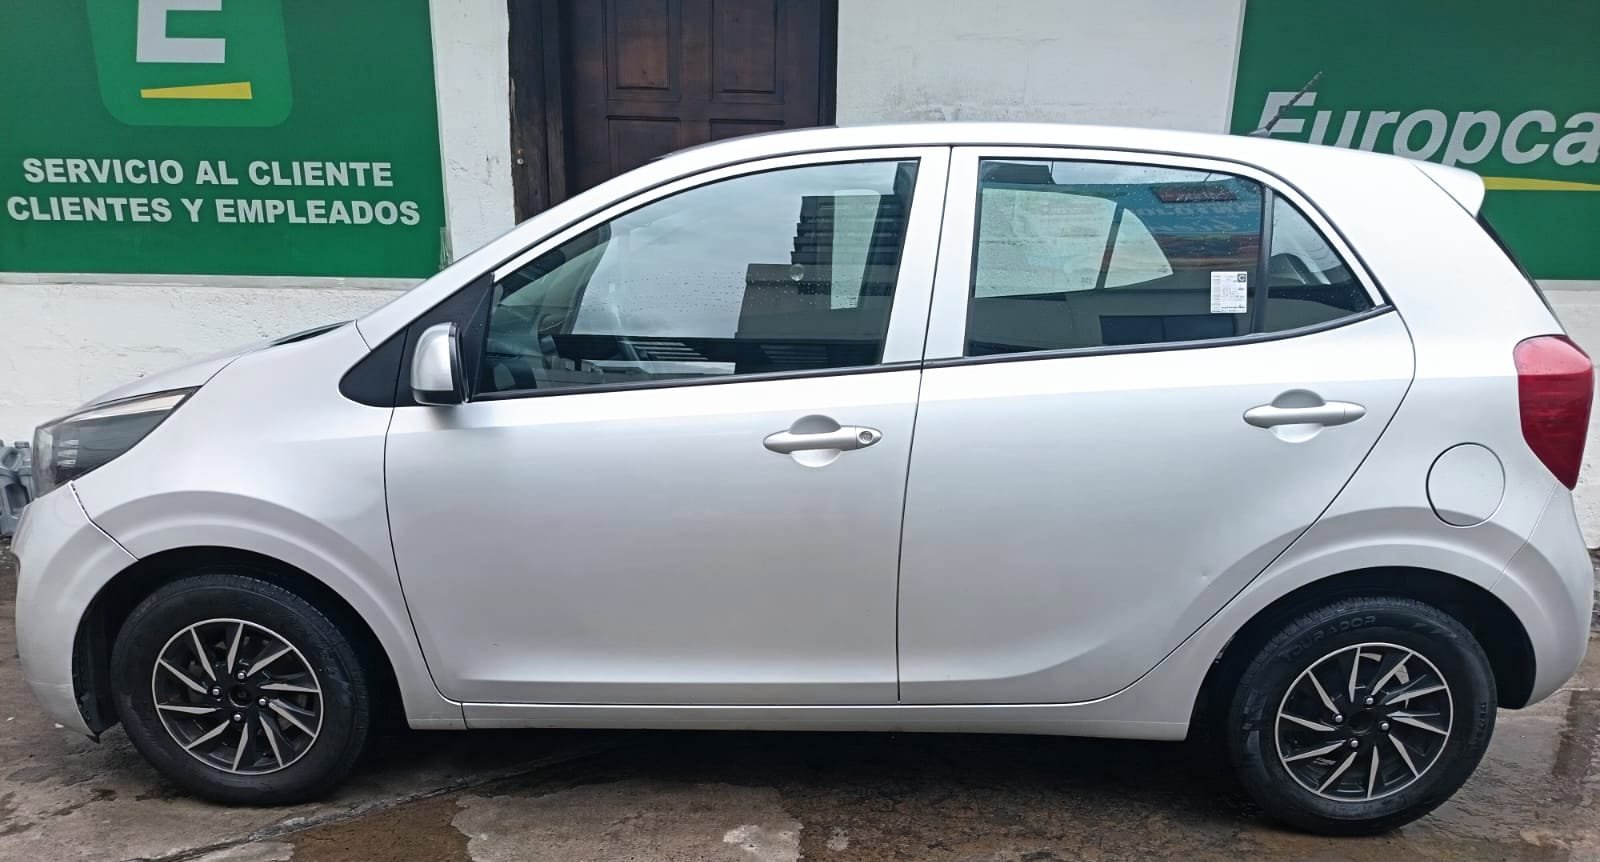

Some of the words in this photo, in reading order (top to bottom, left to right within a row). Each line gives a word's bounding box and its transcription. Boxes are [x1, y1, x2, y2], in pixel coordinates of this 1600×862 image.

[23, 157, 184, 185] SERVICIO
[195, 160, 239, 185] AL
[248, 160, 394, 187] CLIENTE
[7, 196, 173, 223] CLIENTES
[180, 198, 204, 223] Y
[215, 198, 420, 226] EMPLEADOS
